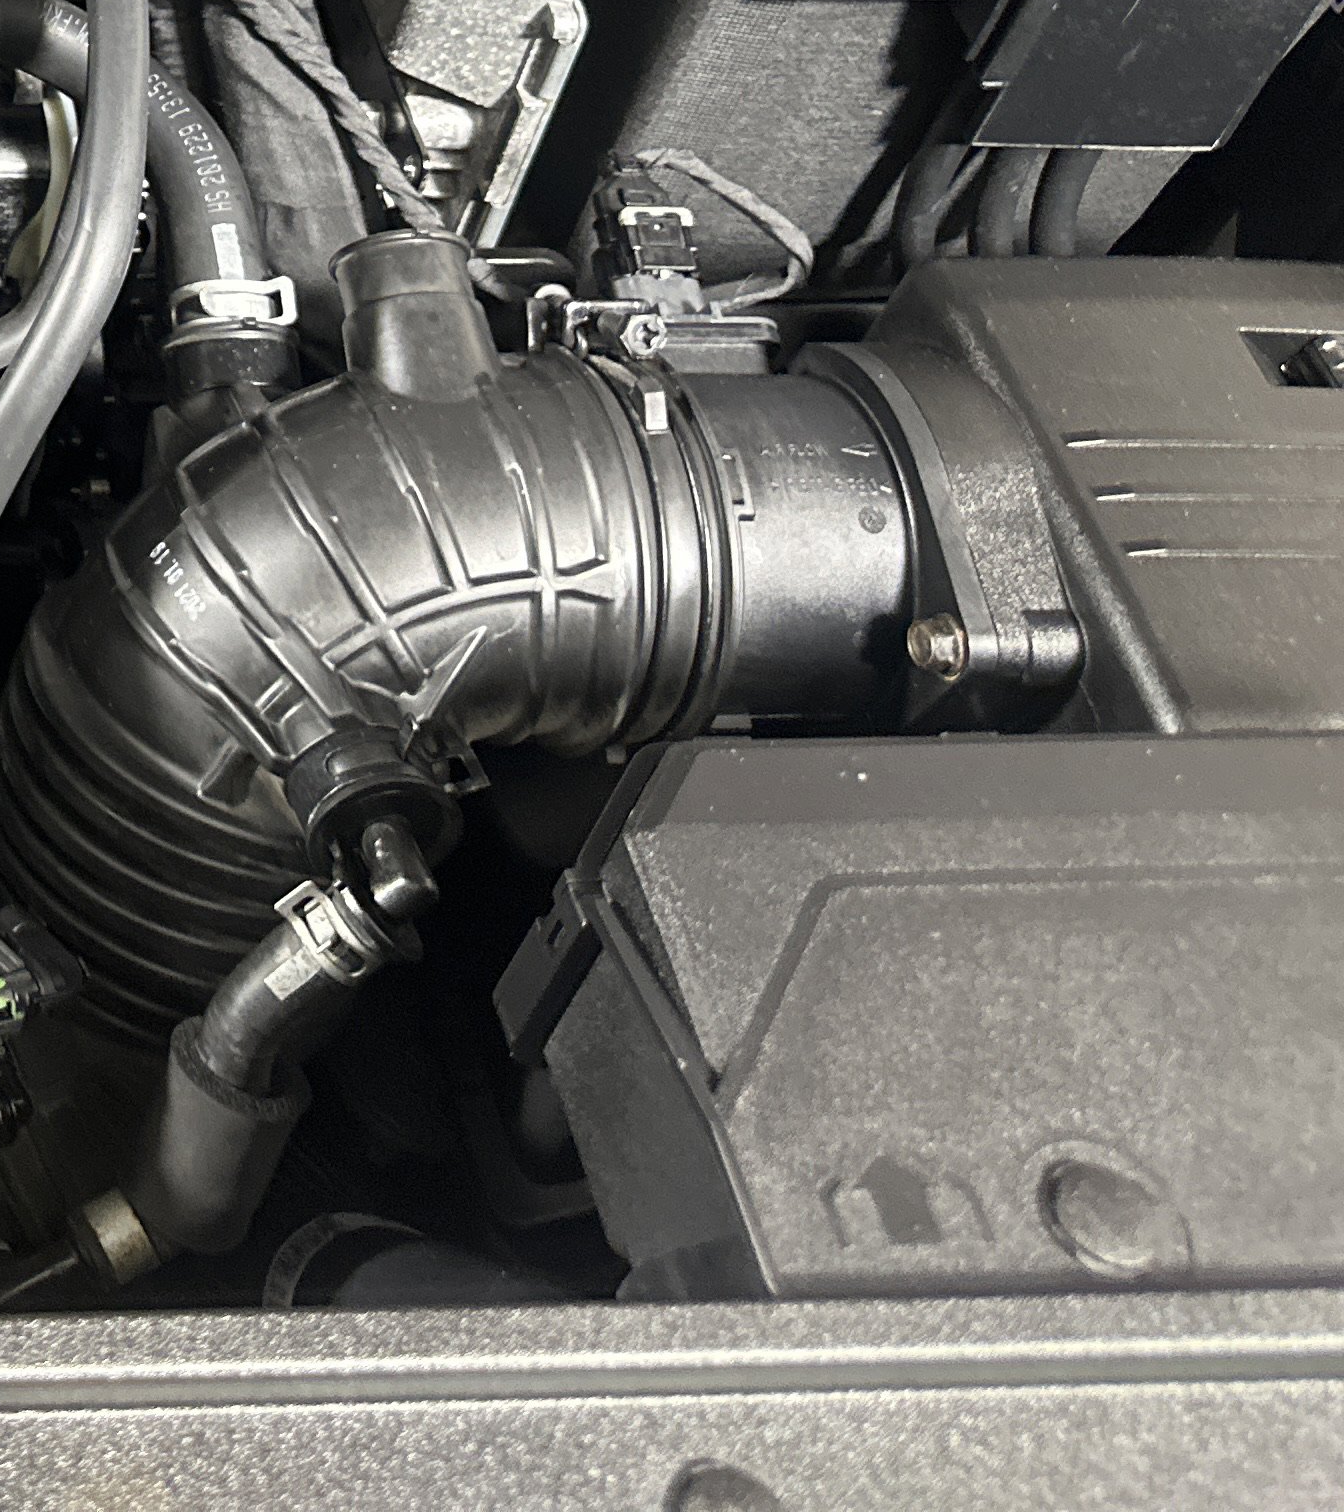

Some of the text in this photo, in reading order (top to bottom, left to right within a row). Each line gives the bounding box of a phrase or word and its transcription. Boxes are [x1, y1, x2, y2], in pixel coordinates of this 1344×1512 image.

[178, 123, 226, 188] 201229
[204, 190, 233, 214] HS
[174, 582, 206, 622] 2021
